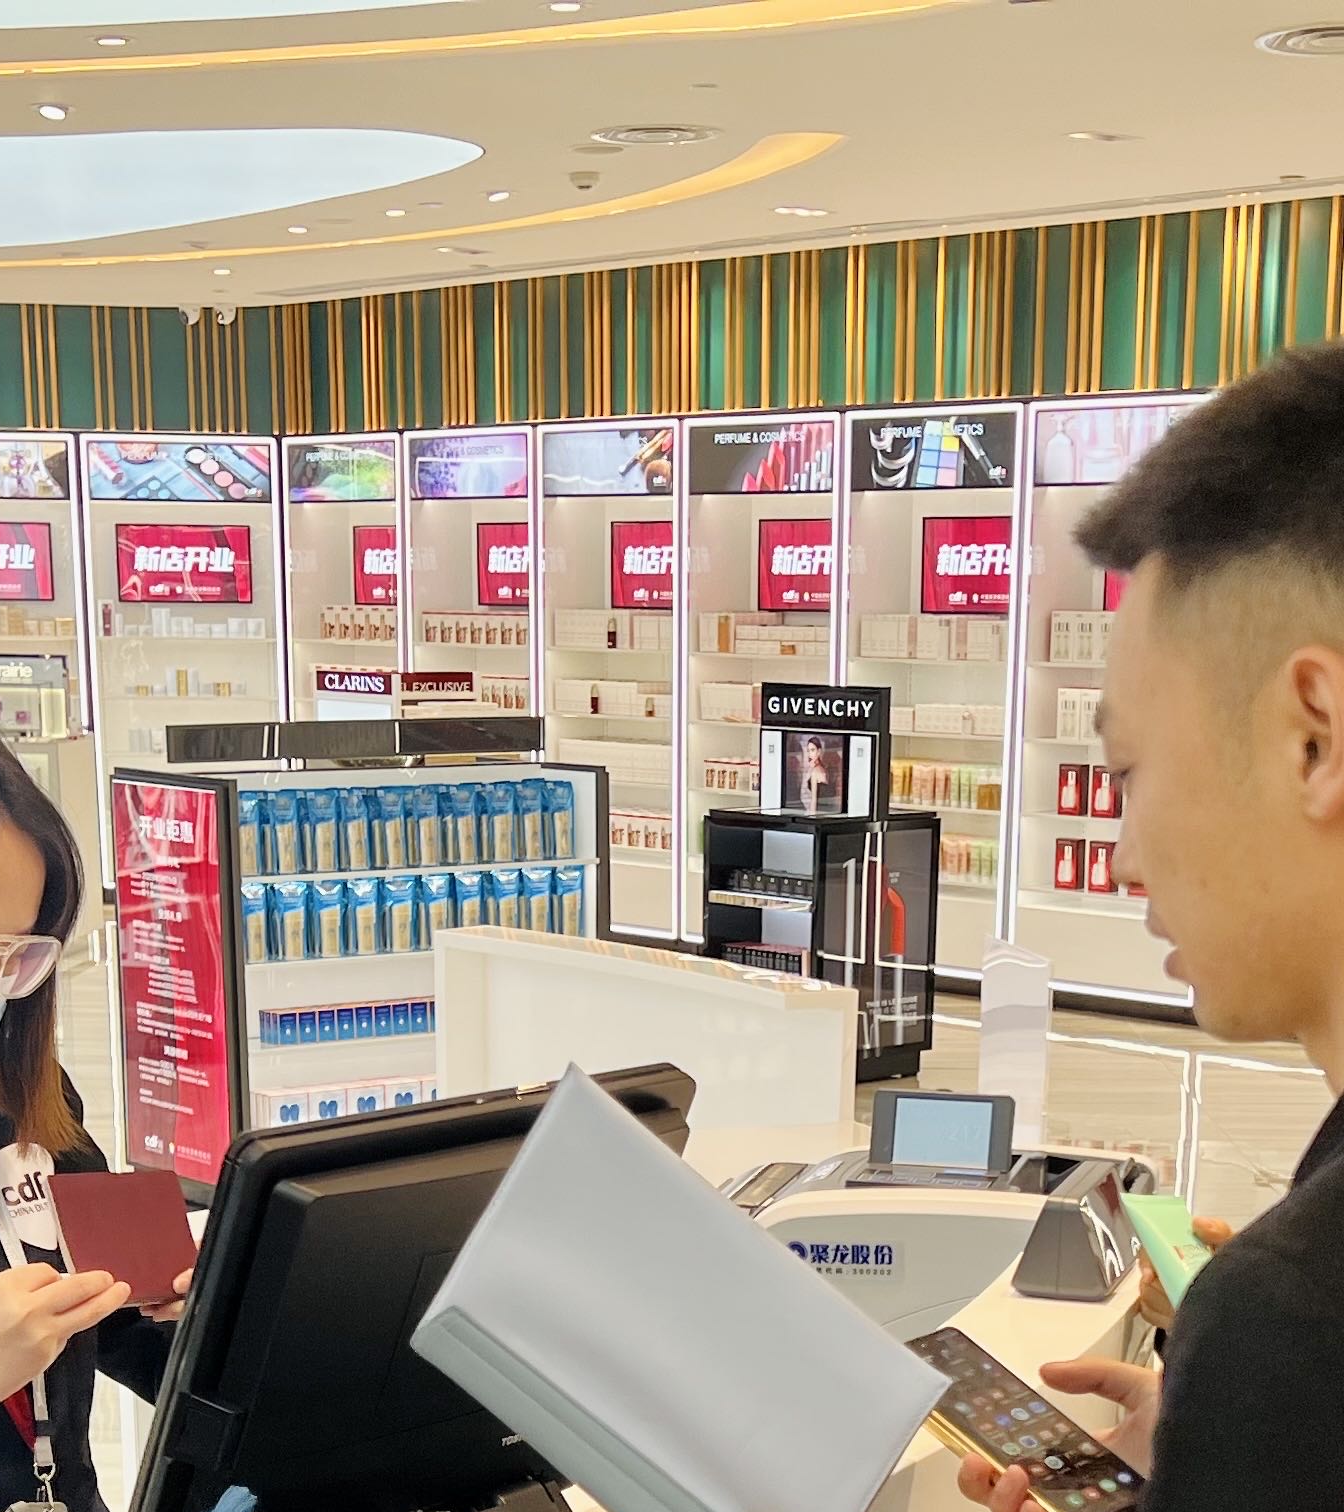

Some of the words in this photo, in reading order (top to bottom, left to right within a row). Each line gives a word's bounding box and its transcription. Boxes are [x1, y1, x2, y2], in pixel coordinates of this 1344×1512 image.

[714, 432, 751, 445] PERFUME
[134, 545, 236, 574] 新店开业
[324, 673, 385, 693] CLARINS
[412, 681, 472, 693] EXCLUSIVE
[767, 695, 874, 719] GIVENCHY
[1, 1170, 46, 1207] cdf
[8, 1206, 35, 1218] CHINA
[810, 1243, 893, 1265] 聚龙股份
